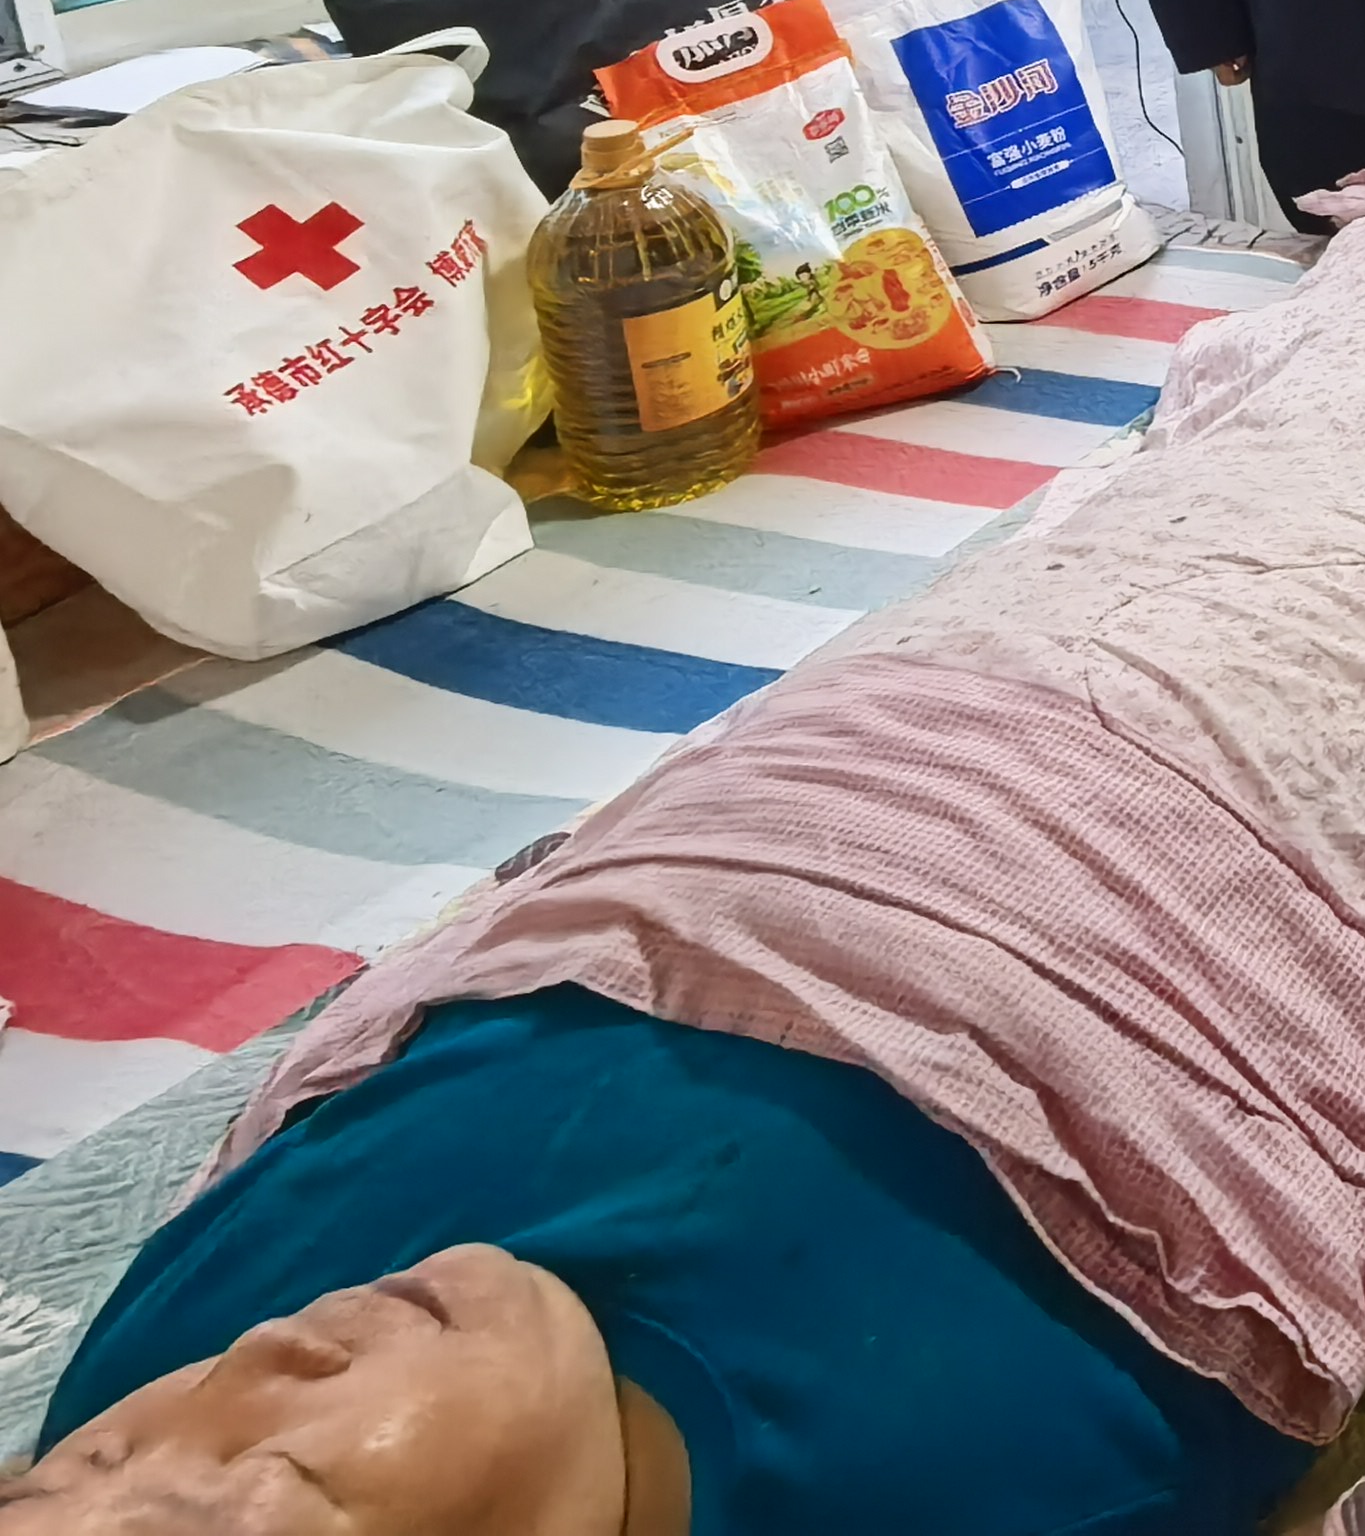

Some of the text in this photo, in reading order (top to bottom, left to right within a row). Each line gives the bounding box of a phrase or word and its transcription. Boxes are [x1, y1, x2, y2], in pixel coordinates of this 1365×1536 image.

[986, 124, 1068, 170] 富强小麦粉
[223, 285, 435, 417] 承德市红十字会
